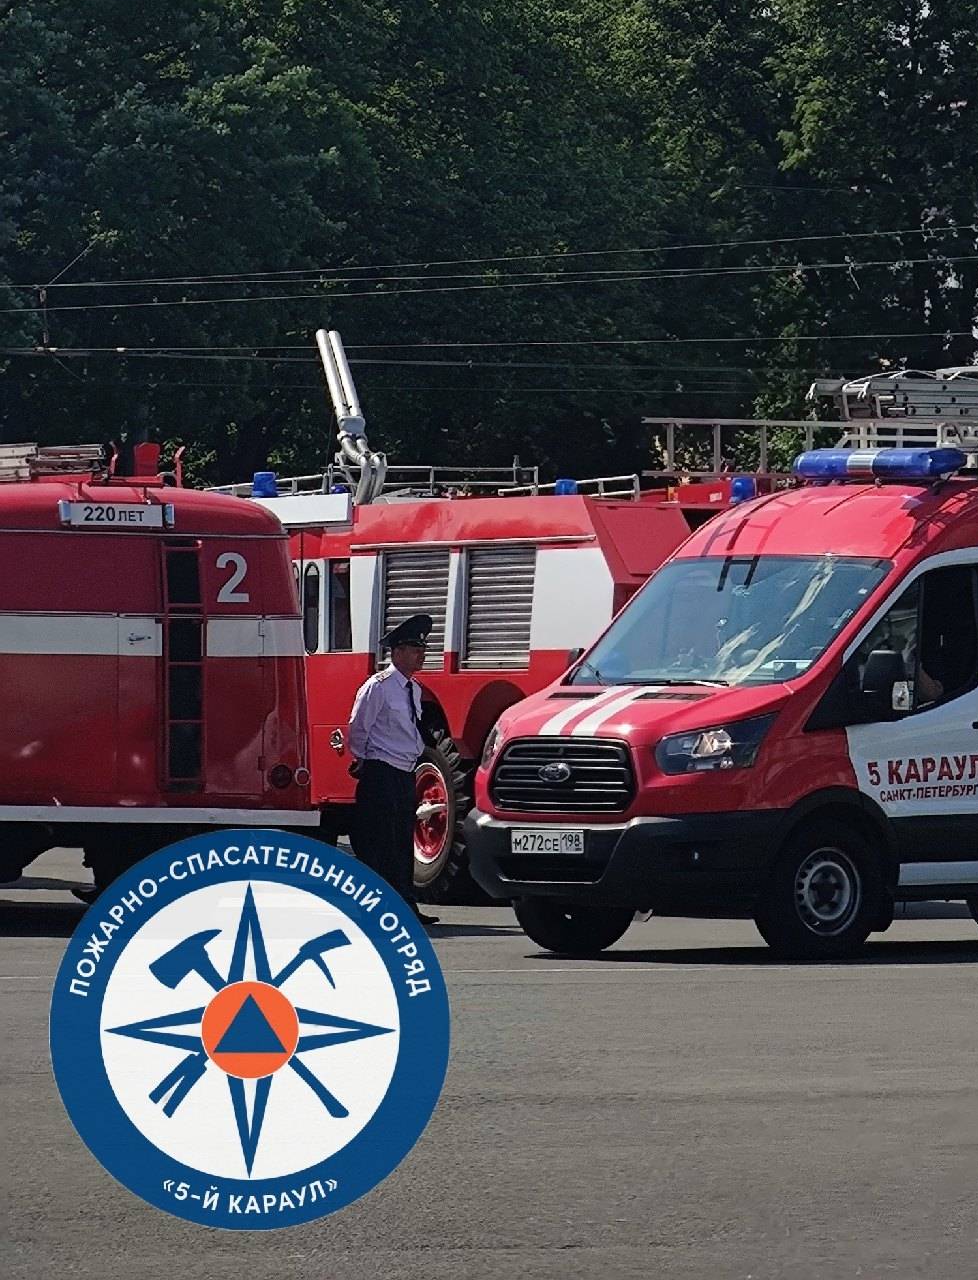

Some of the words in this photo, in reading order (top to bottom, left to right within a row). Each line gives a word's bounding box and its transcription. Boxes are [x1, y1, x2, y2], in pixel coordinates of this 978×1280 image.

[83, 506, 116, 522] 220
[118, 510, 145, 522] ЛЕТ
[216, 552, 250, 603] 2
[867, 761, 881, 786] 5
